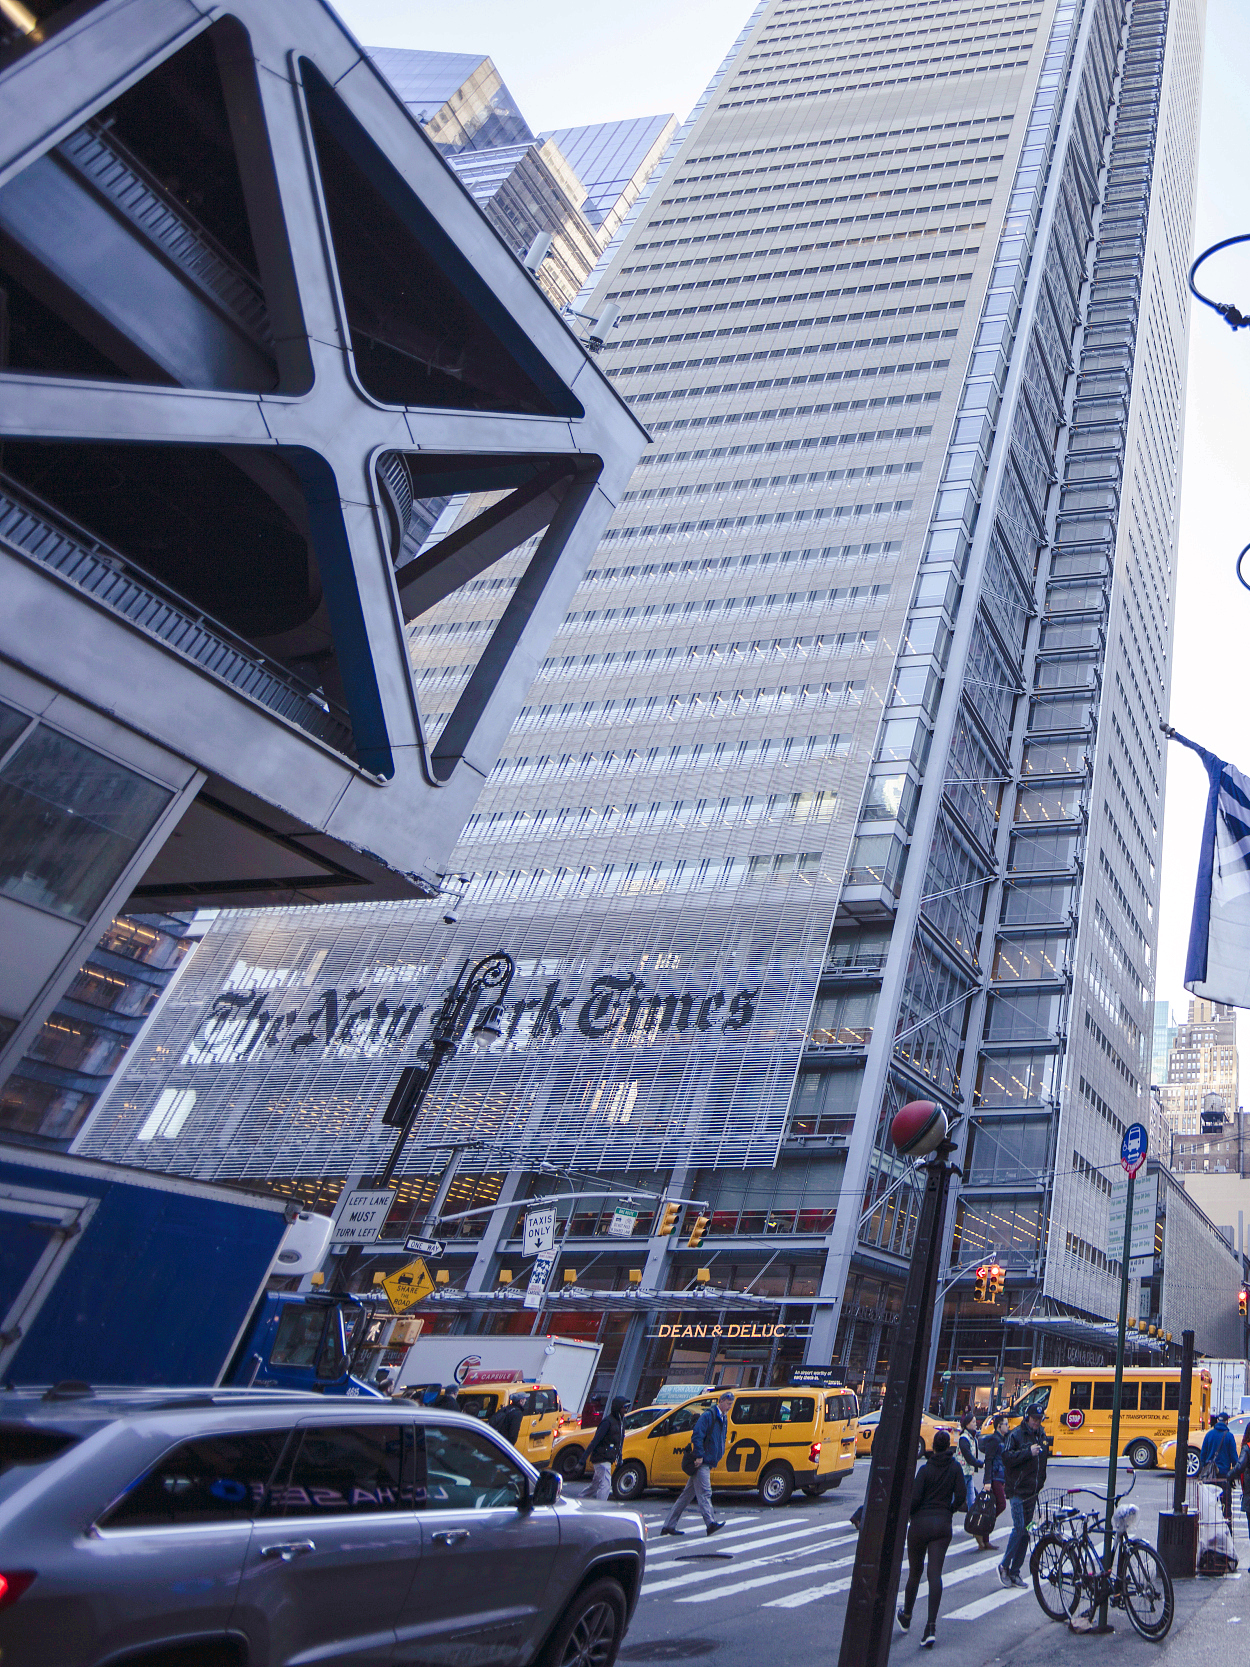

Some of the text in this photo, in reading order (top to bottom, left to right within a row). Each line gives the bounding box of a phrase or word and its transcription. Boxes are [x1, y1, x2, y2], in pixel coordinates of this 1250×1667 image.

[207, 988, 297, 1058] The
[291, 986, 428, 1053] New
[577, 972, 762, 1039] Times
[349, 1196, 390, 1206] LEFT LANE
[349, 1211, 376, 1222] MUST
[528, 1215, 552, 1227] TAXIS
[336, 1228, 377, 1237] TURN LEFT
[528, 1226, 551, 1238] ONLY
[411, 1241, 440, 1252] ONE WAY
[396, 1285, 418, 1294] SHARE
[658, 1324, 708, 1338] DEAN
[711, 1324, 723, 1337] &
[1068, 1414, 1081, 1423] STOP
